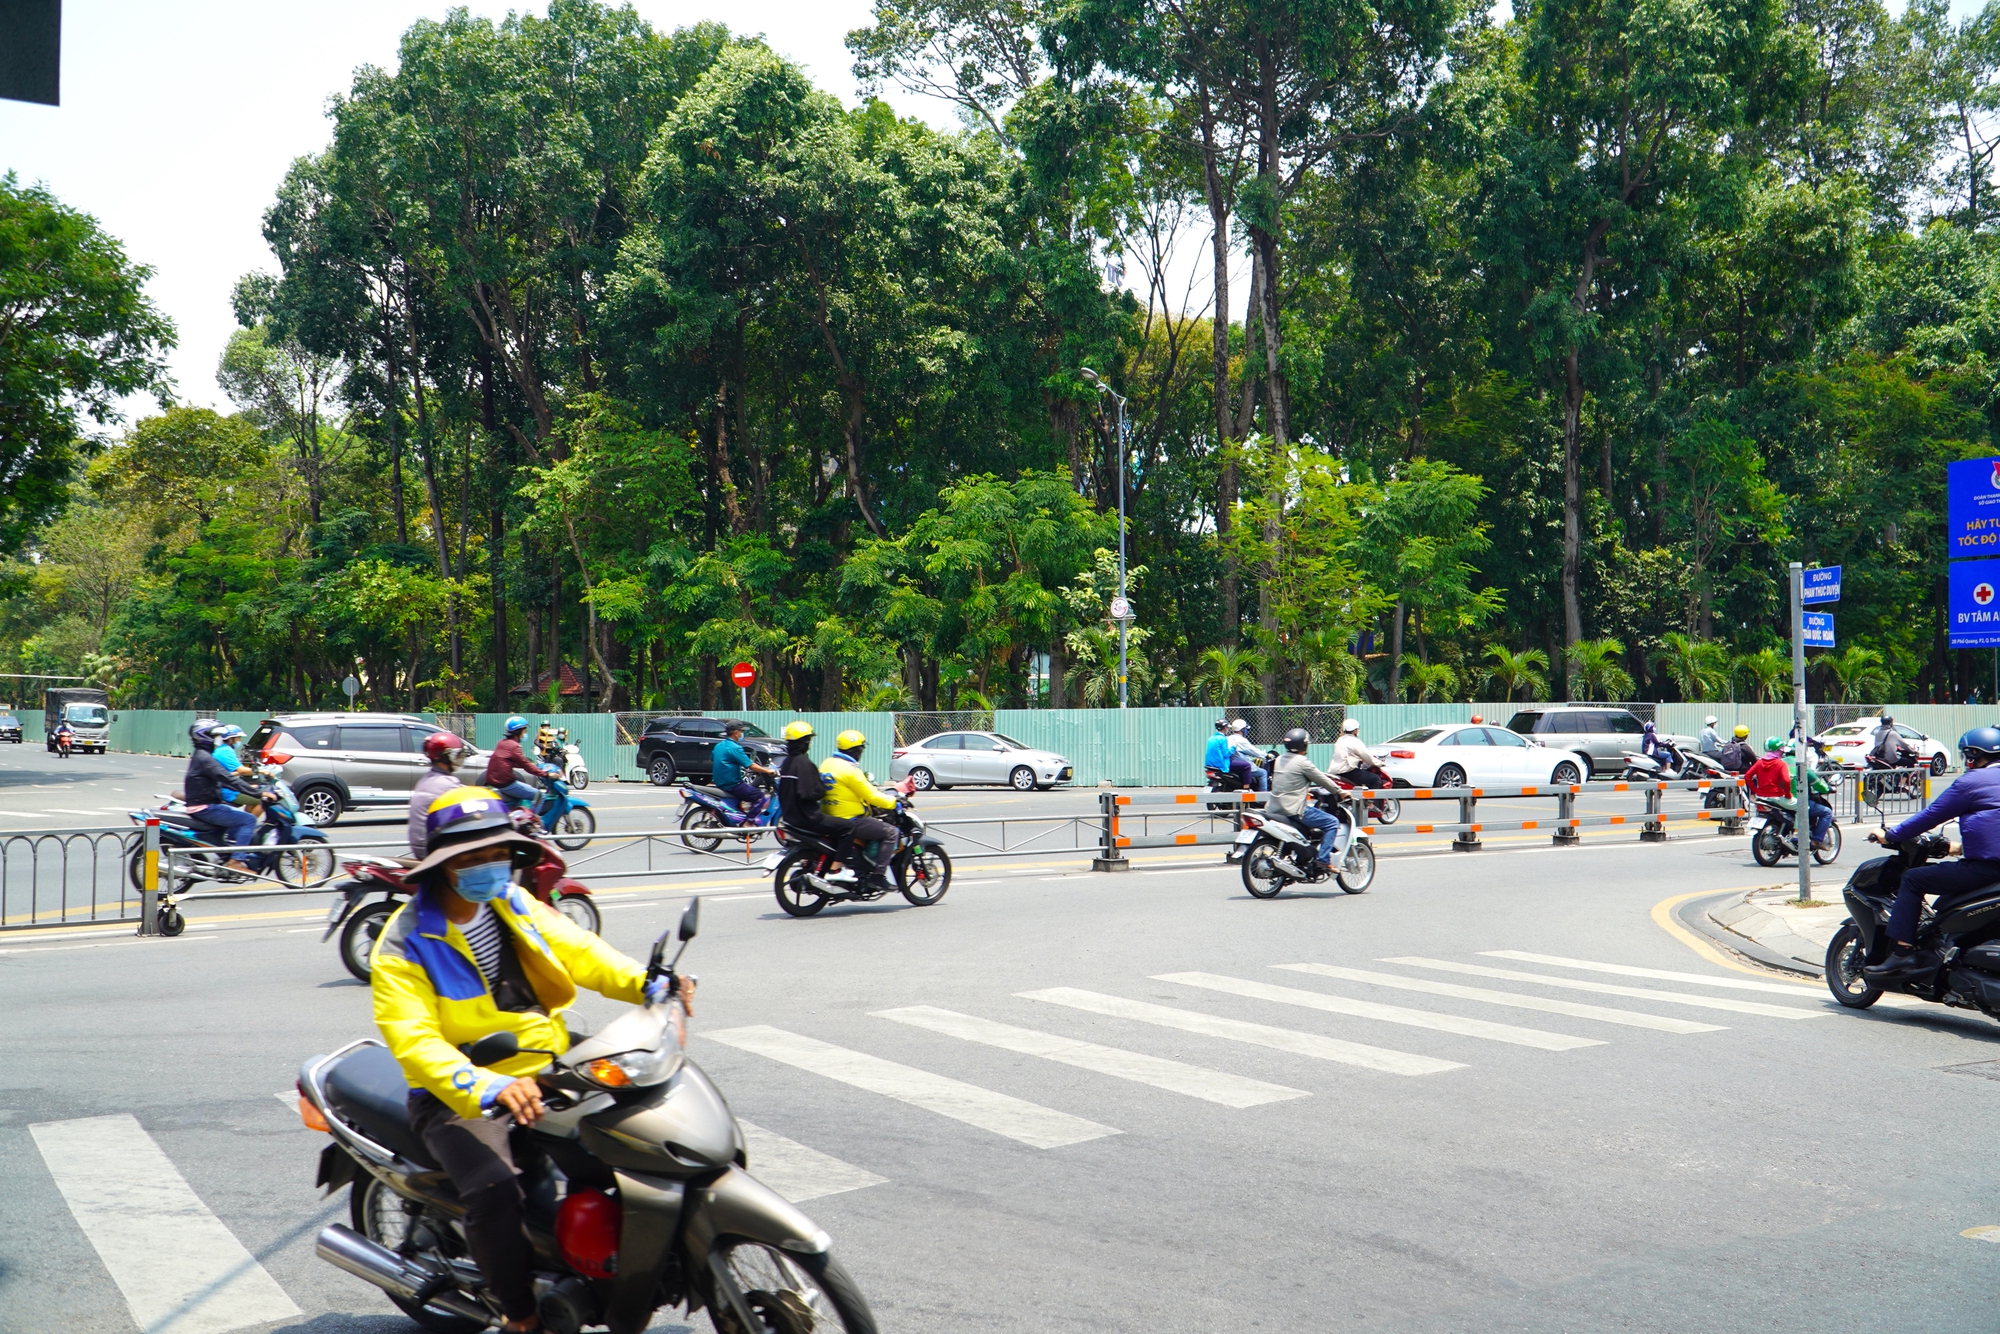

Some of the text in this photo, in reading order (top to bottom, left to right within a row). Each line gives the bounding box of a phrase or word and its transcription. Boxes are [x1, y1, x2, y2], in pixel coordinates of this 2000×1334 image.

[1966, 518, 1988, 531] HÃY
[1958, 533, 1979, 547] TỐC
[1980, 532, 1997, 546] ĐỘ
[1958, 612, 1970, 624] BV
[1971, 609, 1991, 623] TÂM
